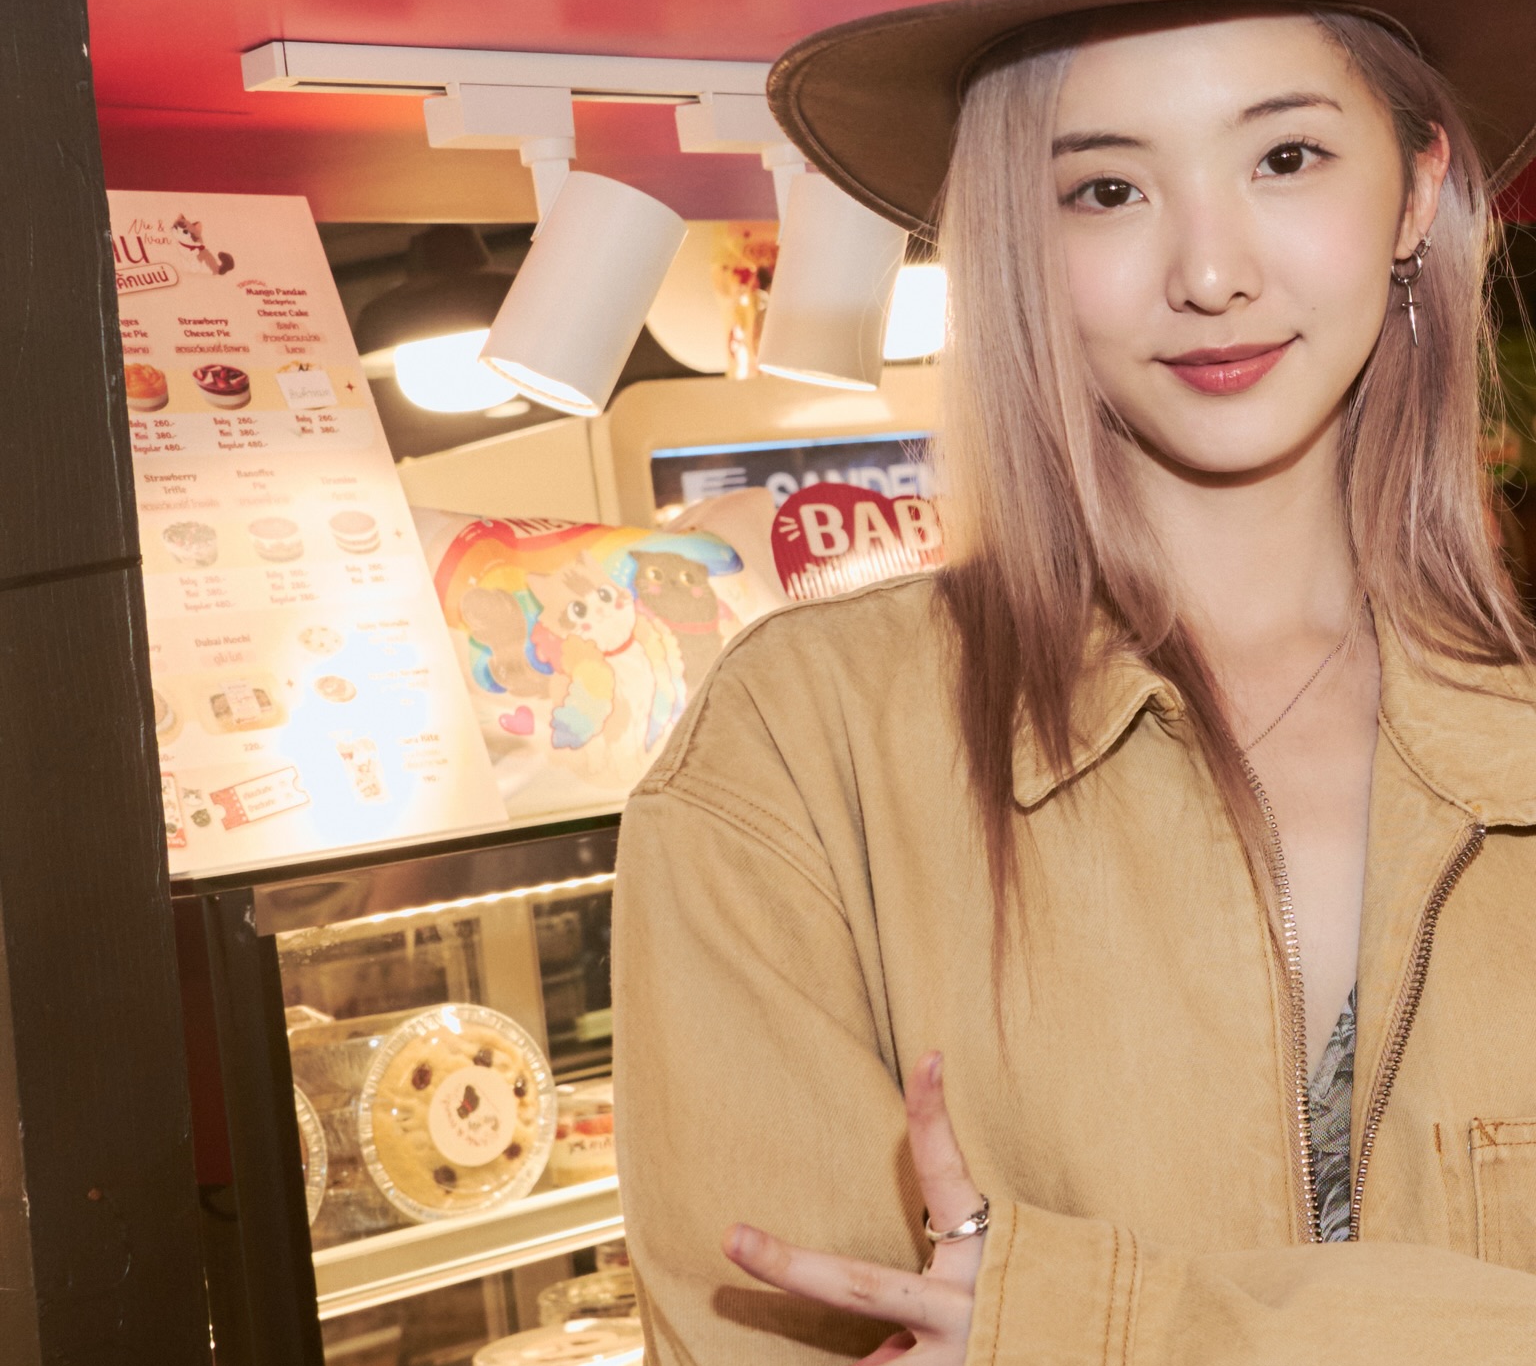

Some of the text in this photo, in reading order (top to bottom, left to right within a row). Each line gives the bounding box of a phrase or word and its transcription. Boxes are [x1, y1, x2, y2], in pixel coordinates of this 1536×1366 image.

[144, 233, 171, 245] Ivan
[116, 266, 169, 290] ค้กเนเน่
[245, 287, 308, 297] Mango Pandan
[257, 309, 310, 317] Cheese Cake
[177, 317, 229, 327] Strawberry
[133, 329, 149, 338] Pie
[183, 329, 231, 338] Cheese Pie
[143, 473, 198, 483] Strawberry
[162, 485, 187, 495] Trifle
[194, 633, 252, 648] Dubai Mochi
